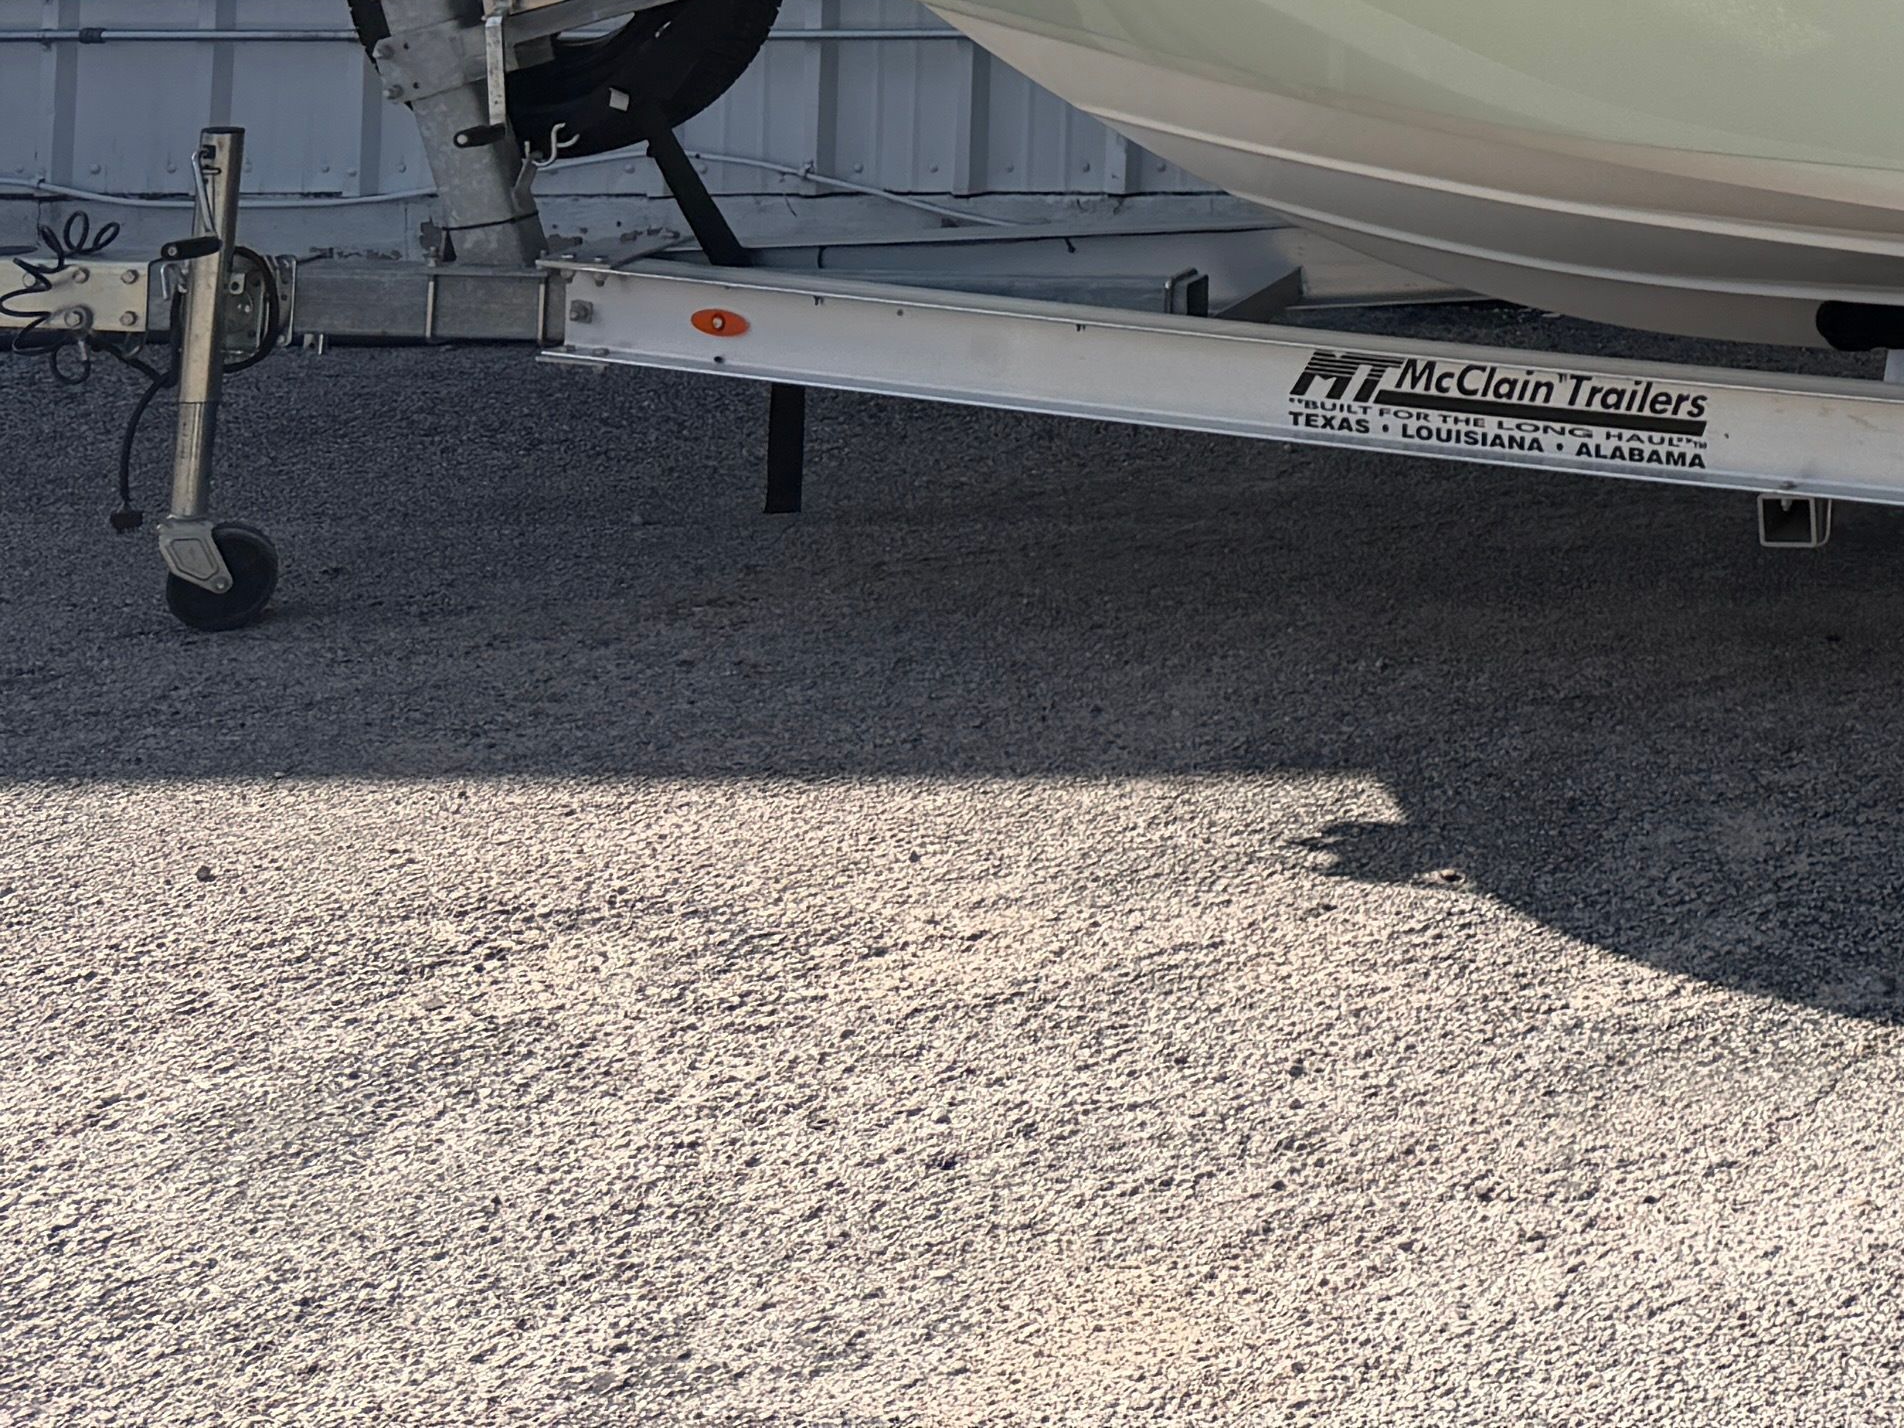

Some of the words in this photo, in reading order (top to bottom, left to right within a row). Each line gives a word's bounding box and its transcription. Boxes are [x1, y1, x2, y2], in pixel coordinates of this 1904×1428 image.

[1567, 374, 1709, 419] Trailers
[1288, 410, 1370, 434] TEXAS
[1401, 423, 1545, 453] LOUISIANA
[1575, 442, 1707, 469] ALABAMA
[1378, 407, 1432, 423] FOR
[1437, 413, 1486, 428] THE
[1497, 420, 1594, 439] LONG
